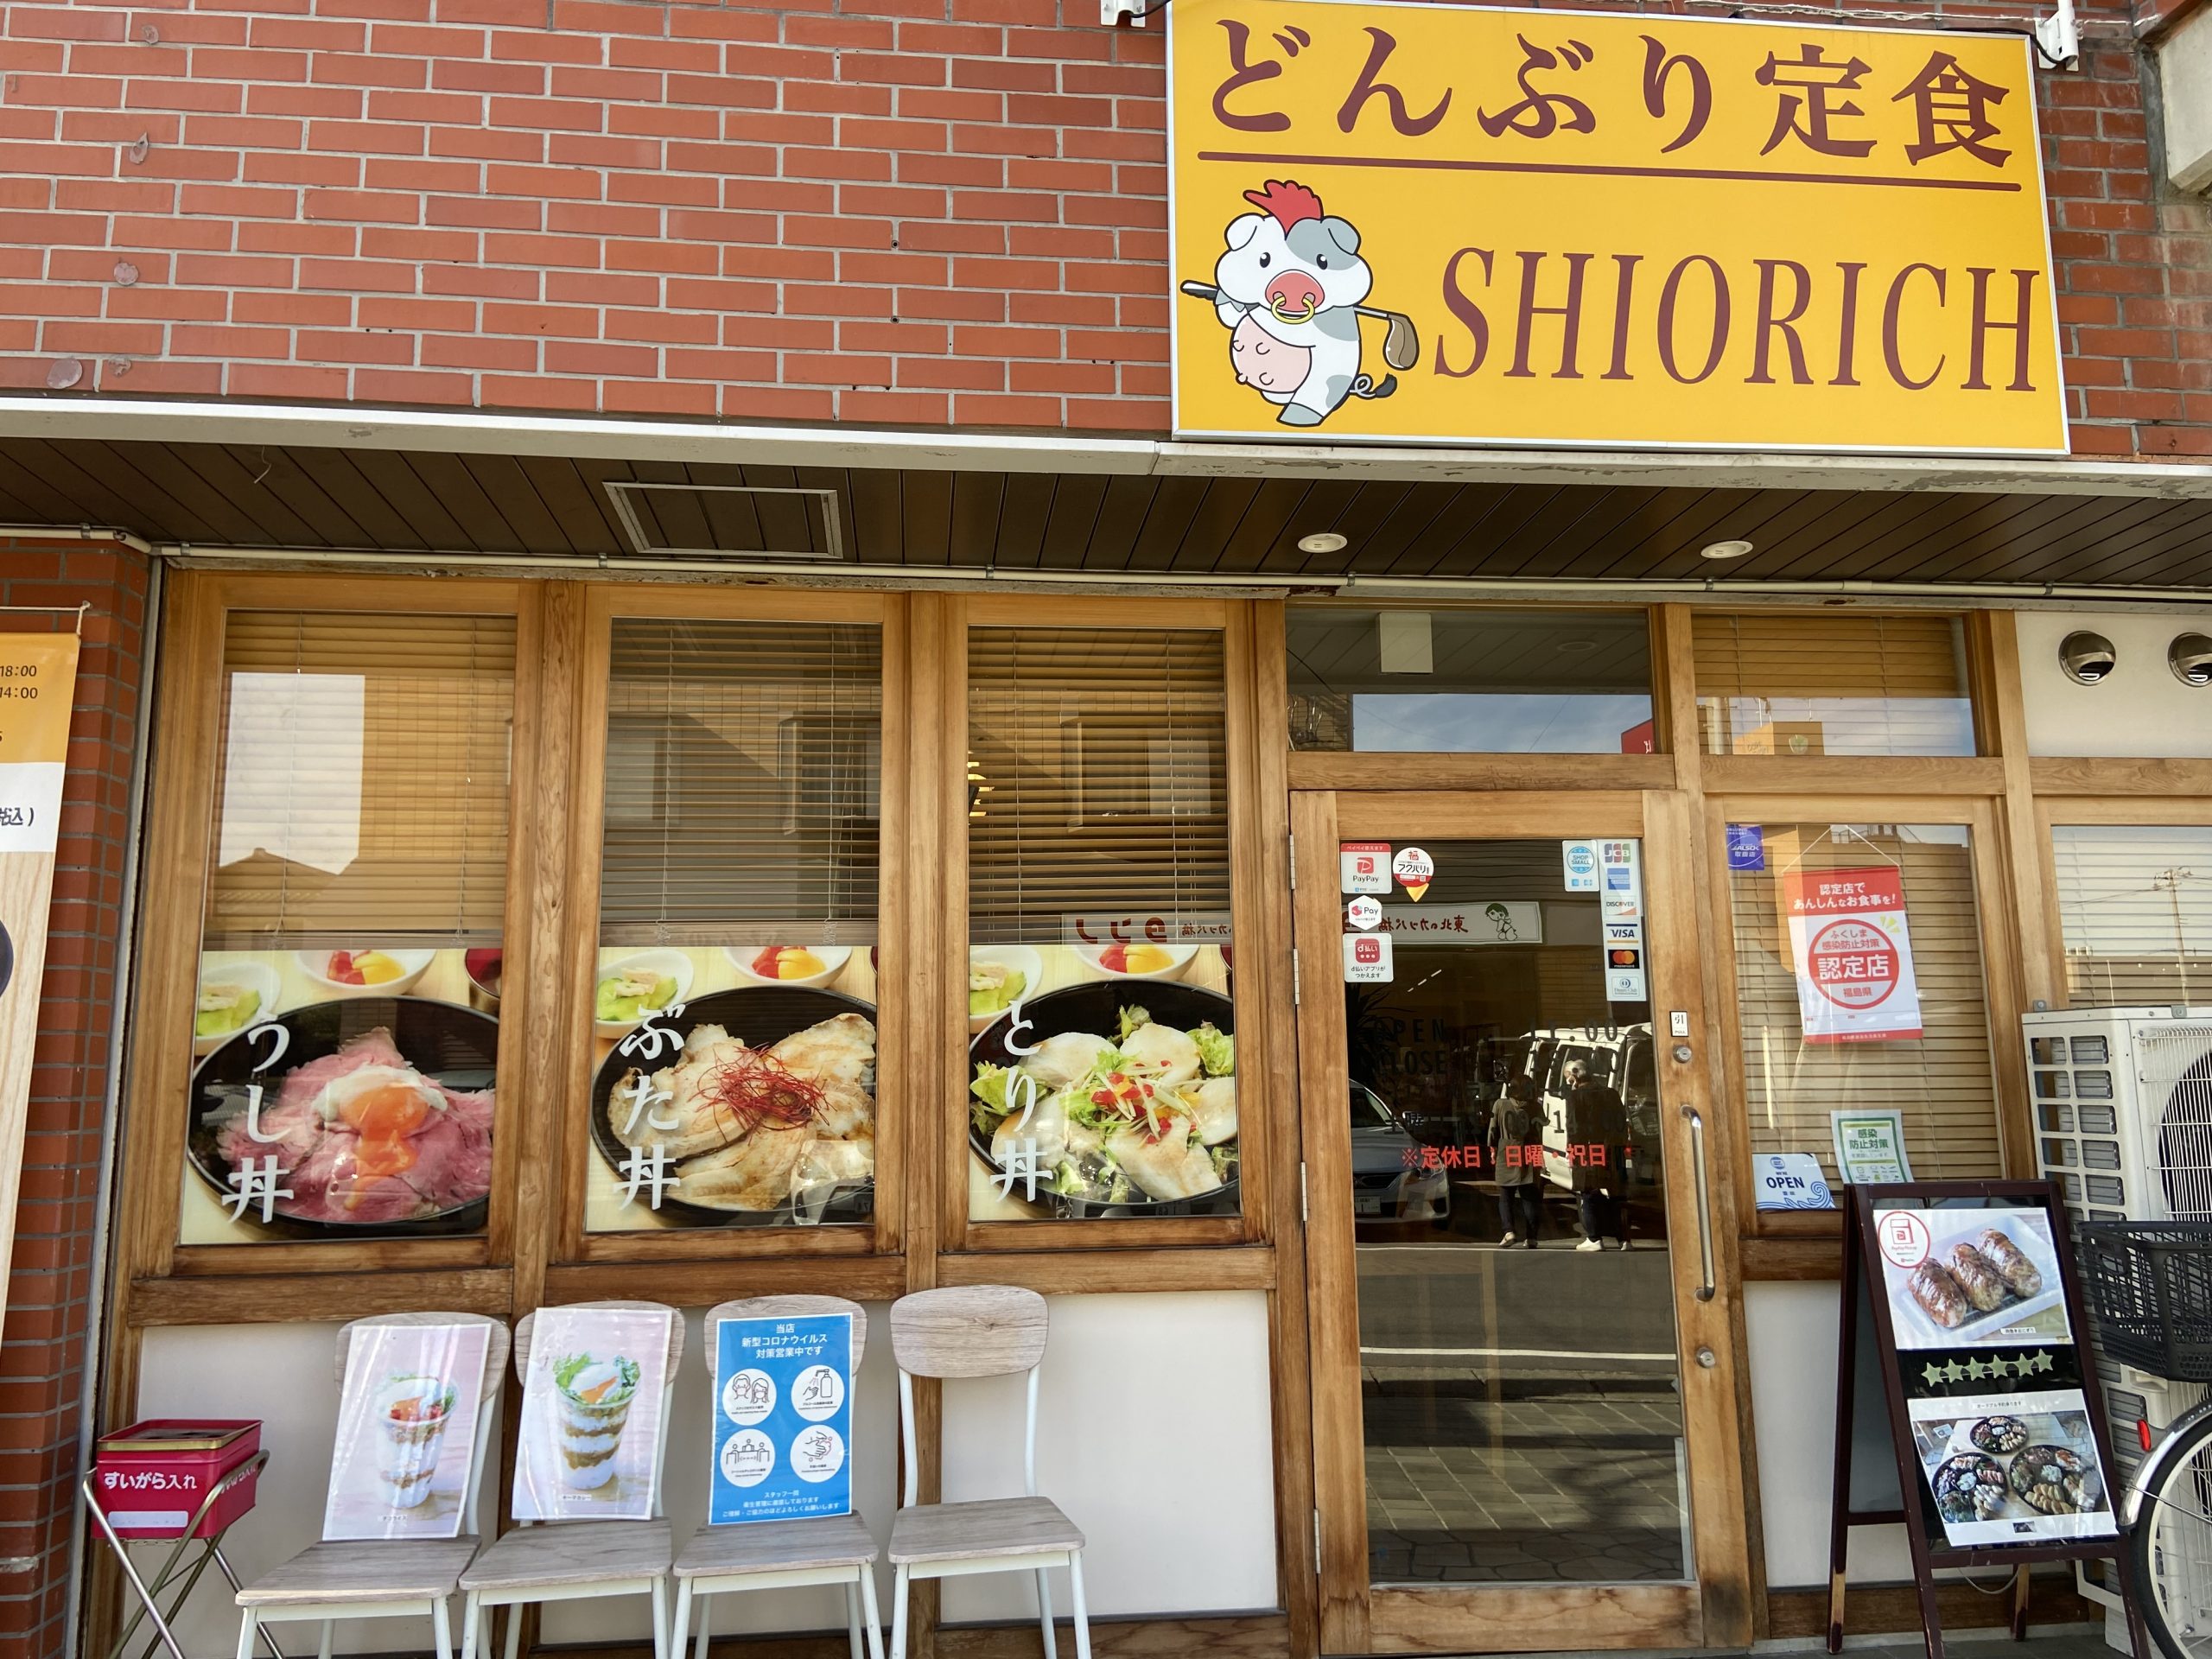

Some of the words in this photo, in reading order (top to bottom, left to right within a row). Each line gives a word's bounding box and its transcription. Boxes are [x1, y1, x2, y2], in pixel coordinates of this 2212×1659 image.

[1212, 19, 2014, 168] どんぶり定食
[1434, 246, 2040, 392] SHIORICH
[1819, 882, 1866, 896] 認定店で
[1363, 906, 1378, 915] Pay
[1611, 929, 1635, 938] VISA
[1831, 929, 1867, 939] ふくしま
[1821, 938, 1881, 950] 感染防止対策
[1817, 954, 1890, 981] 認定店
[613, 1003, 686, 1211] ぶた丼
[989, 1000, 1053, 1204] とり丼
[221, 1007, 295, 1224] うし丼
[1858, 1128, 1878, 1138] 感染
[1849, 1139, 1889, 1149] 防止対策
[1766, 1177, 1805, 1188] OPEN
[776, 1323, 795, 1334] 当店
[741, 1333, 828, 1348] 新型コロナウイルス
[755, 1345, 823, 1359] 対策営業中です
[105, 1471, 197, 1490] すいがら入れ
